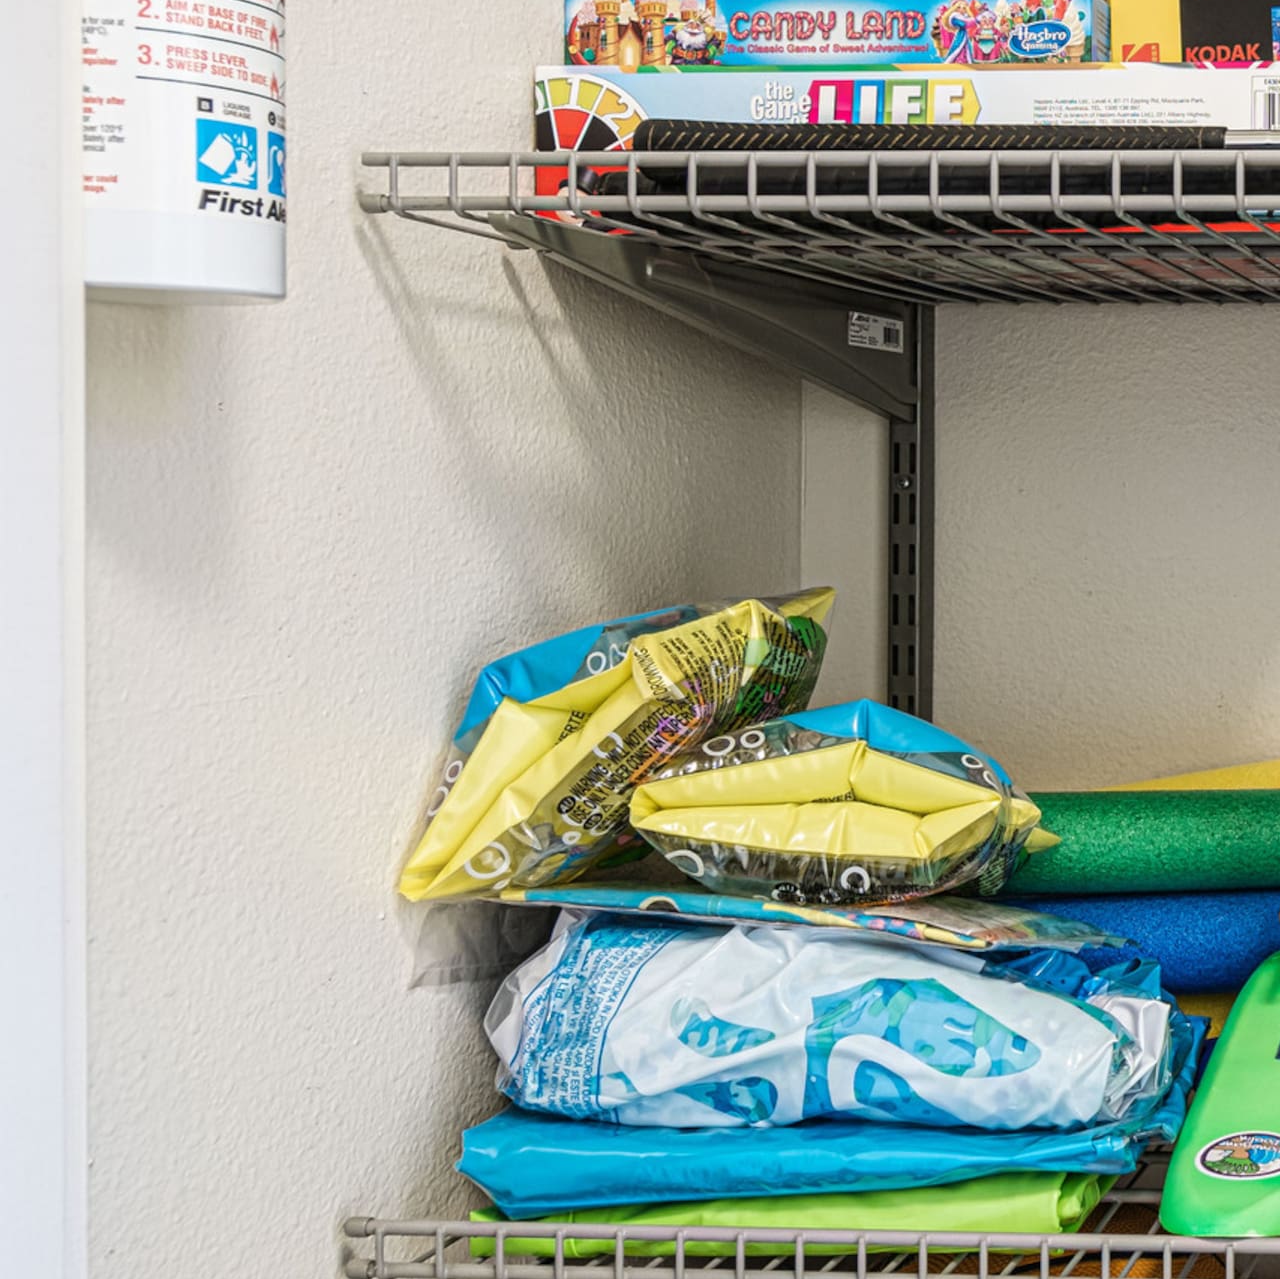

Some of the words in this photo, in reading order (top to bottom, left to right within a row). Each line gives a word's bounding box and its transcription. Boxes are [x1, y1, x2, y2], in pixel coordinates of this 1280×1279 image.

[166, 0, 188, 12] AIM
[192, 3, 206, 14] AT
[208, 6, 234, 20] BASE
[237, 11, 248, 23] OF
[166, 12, 203, 27] STAND
[208, 18, 234, 33] BACK
[729, 11, 836, 40] CANDY
[846, 10, 926, 39] LAND
[1017, 24, 1067, 42] Hasbro
[137, 44, 160, 66] 3.
[166, 45, 208, 61] PRESS
[212, 51, 248, 69] LEVER.
[726, 44, 744, 53] The
[747, 43, 784, 53] Classic
[787, 44, 816, 53] Game
[819, 43, 829, 53] of
[833, 43, 864, 53] Sweet
[867, 43, 929, 53] Adventures!
[1022, 40, 1060, 52] Gaming
[1185, 42, 1261, 62] KODAK
[166, 58, 207, 73] SWEEP
[211, 64, 234, 78] SIDE
[237, 70, 248, 82] TO
[764, 80, 793, 101] the
[751, 93, 812, 120] Game
[818, 85, 963, 124] LIFE
[198, 189, 263, 217] First
[569, 763, 609, 799] WARNING
[605, 743, 630, 765] WILL
[622, 728, 640, 750] NOT
[568, 805, 588, 824] USE
[583, 785, 611, 810] ONLY
[603, 763, 632, 791] UNDER
[626, 731, 668, 769] CONSTANT
